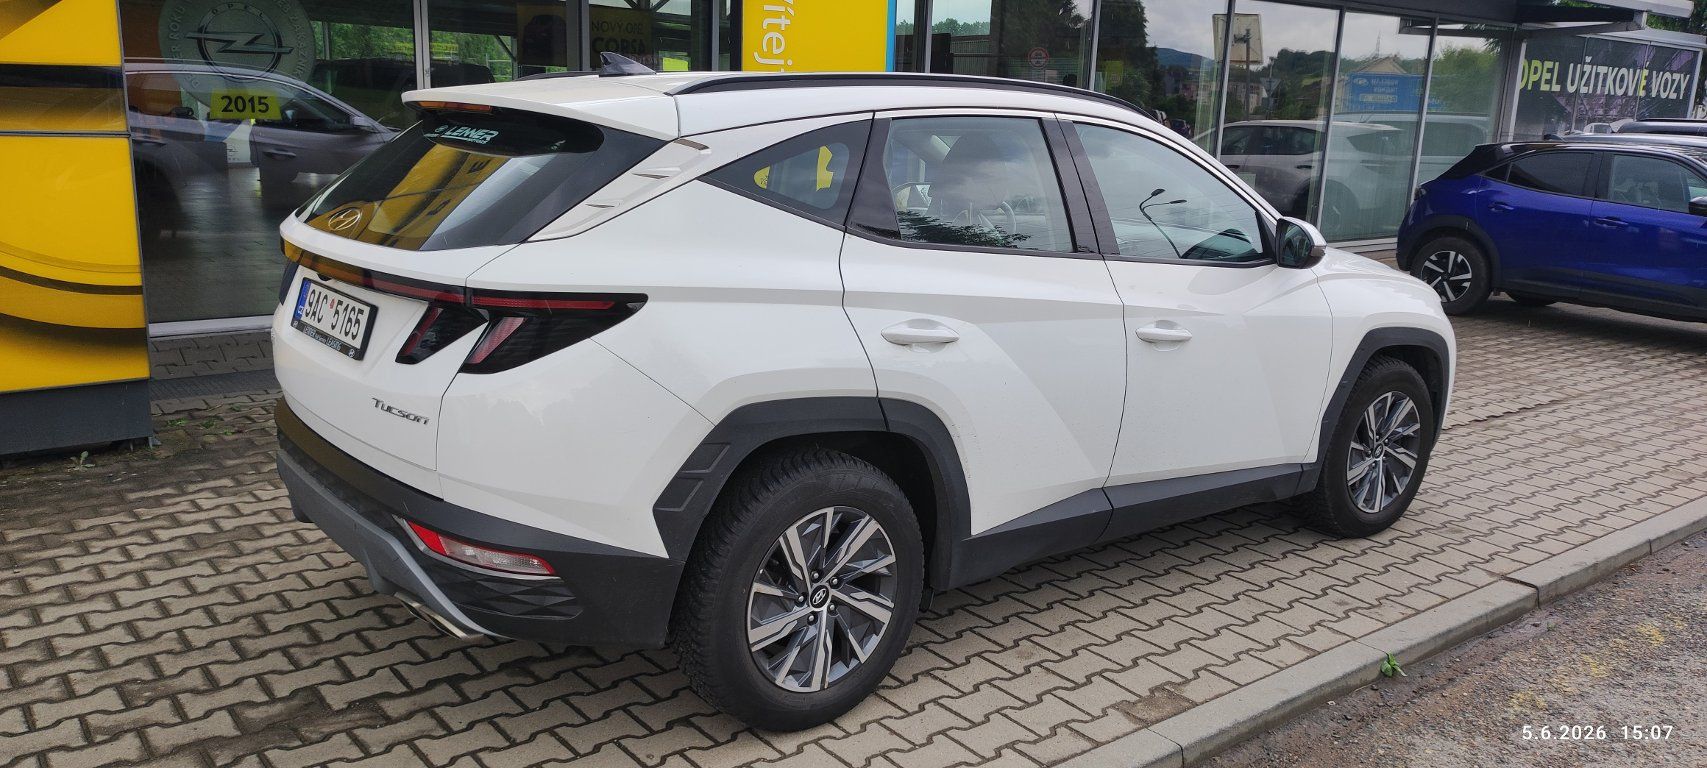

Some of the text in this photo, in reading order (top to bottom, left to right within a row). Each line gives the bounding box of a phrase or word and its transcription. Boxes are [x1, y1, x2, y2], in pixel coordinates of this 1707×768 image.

[753, 0, 795, 72] ítej
[1566, 55, 1649, 97] UŽITKOVÉ
[1651, 70, 1690, 100] VOZY
[220, 95, 270, 114] 2015
[305, 289, 328, 323] 9AC
[331, 299, 364, 340] 5165
[371, 397, 430, 425] TUCSON
